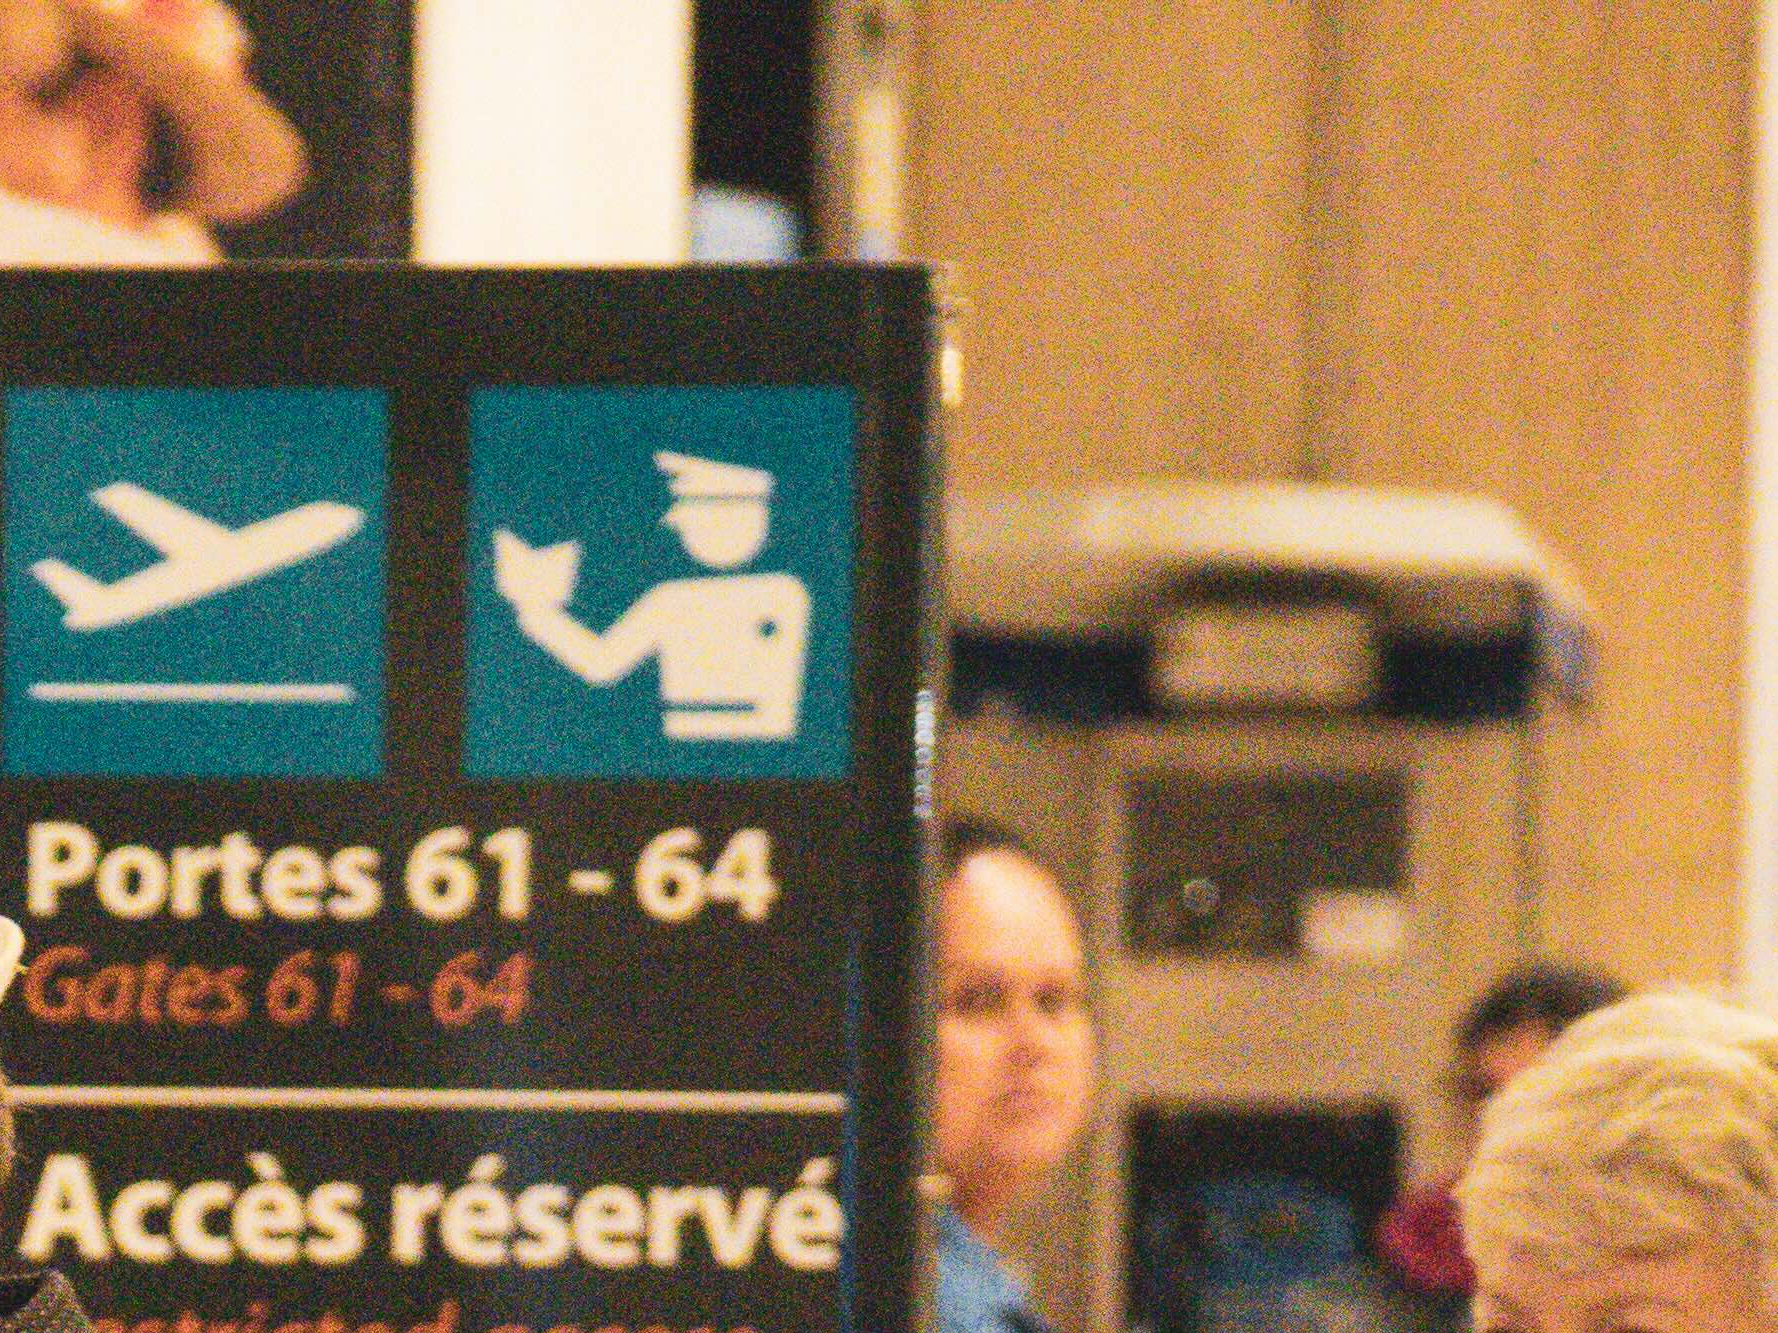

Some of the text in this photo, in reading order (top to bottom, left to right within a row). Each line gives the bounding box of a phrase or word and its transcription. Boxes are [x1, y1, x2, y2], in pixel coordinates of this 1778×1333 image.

[26, 820, 779, 923] Portes 61 - 64
[24, 944, 537, 1028] Gates 61 - 64
[17, 1150, 843, 1270] Accès réservé
